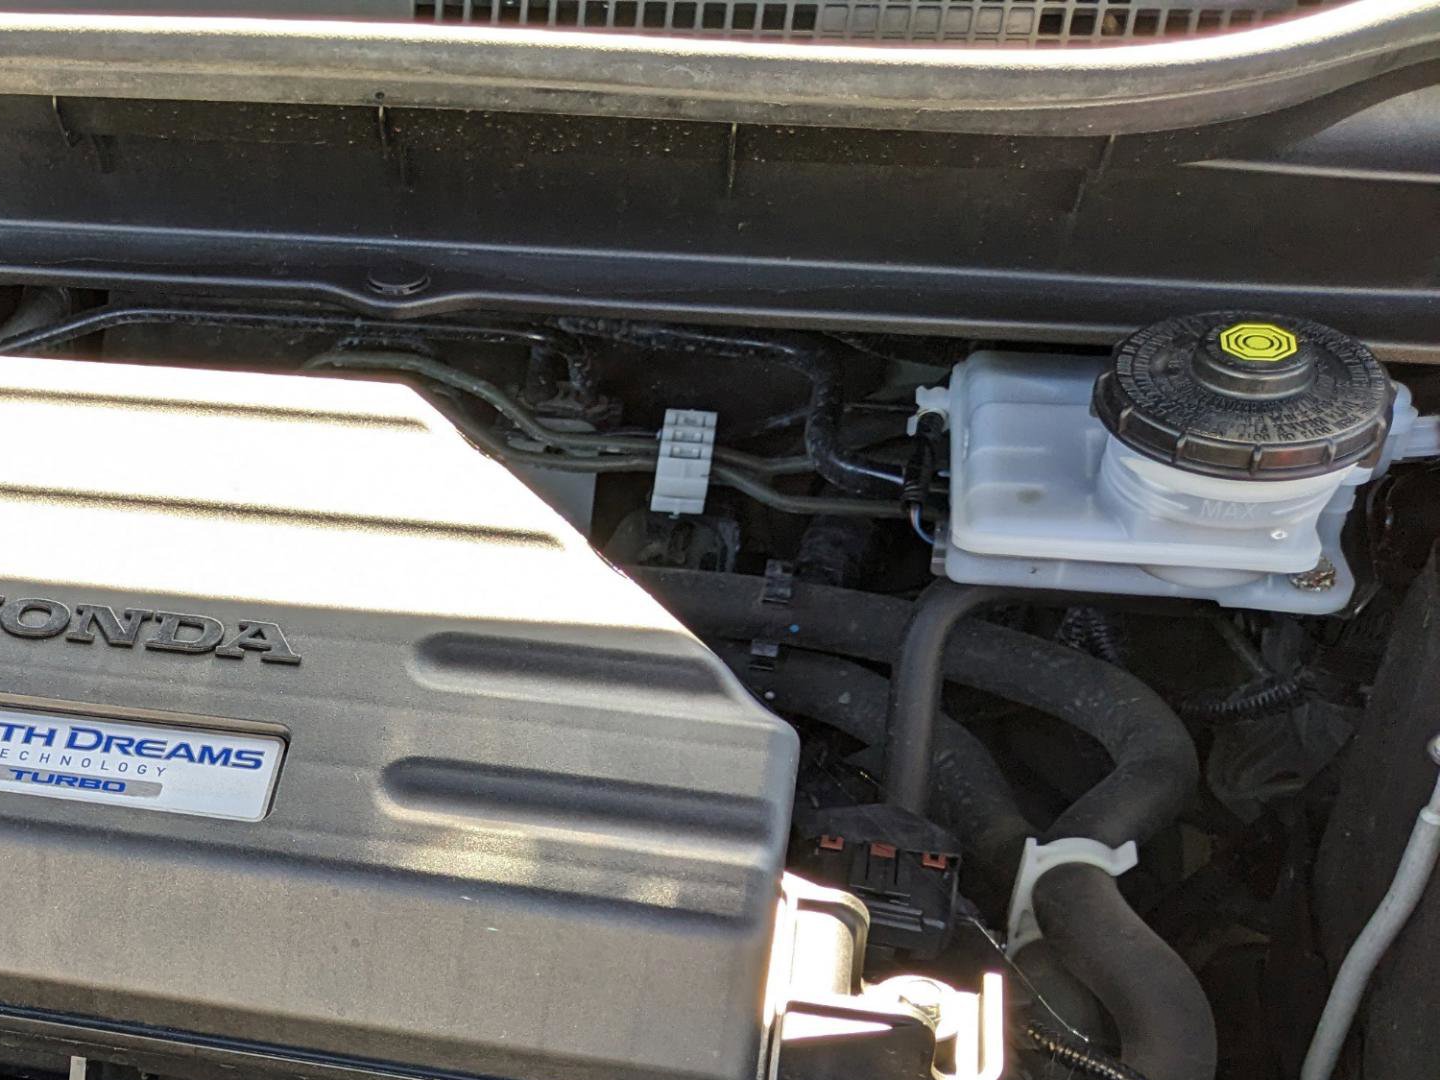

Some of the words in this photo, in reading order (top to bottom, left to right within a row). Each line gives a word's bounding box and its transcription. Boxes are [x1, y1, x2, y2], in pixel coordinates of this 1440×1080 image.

[1199, 501, 1259, 520] MAX
[65, 726, 266, 771] DREAMS
[9, 767, 128, 794] TURBO
